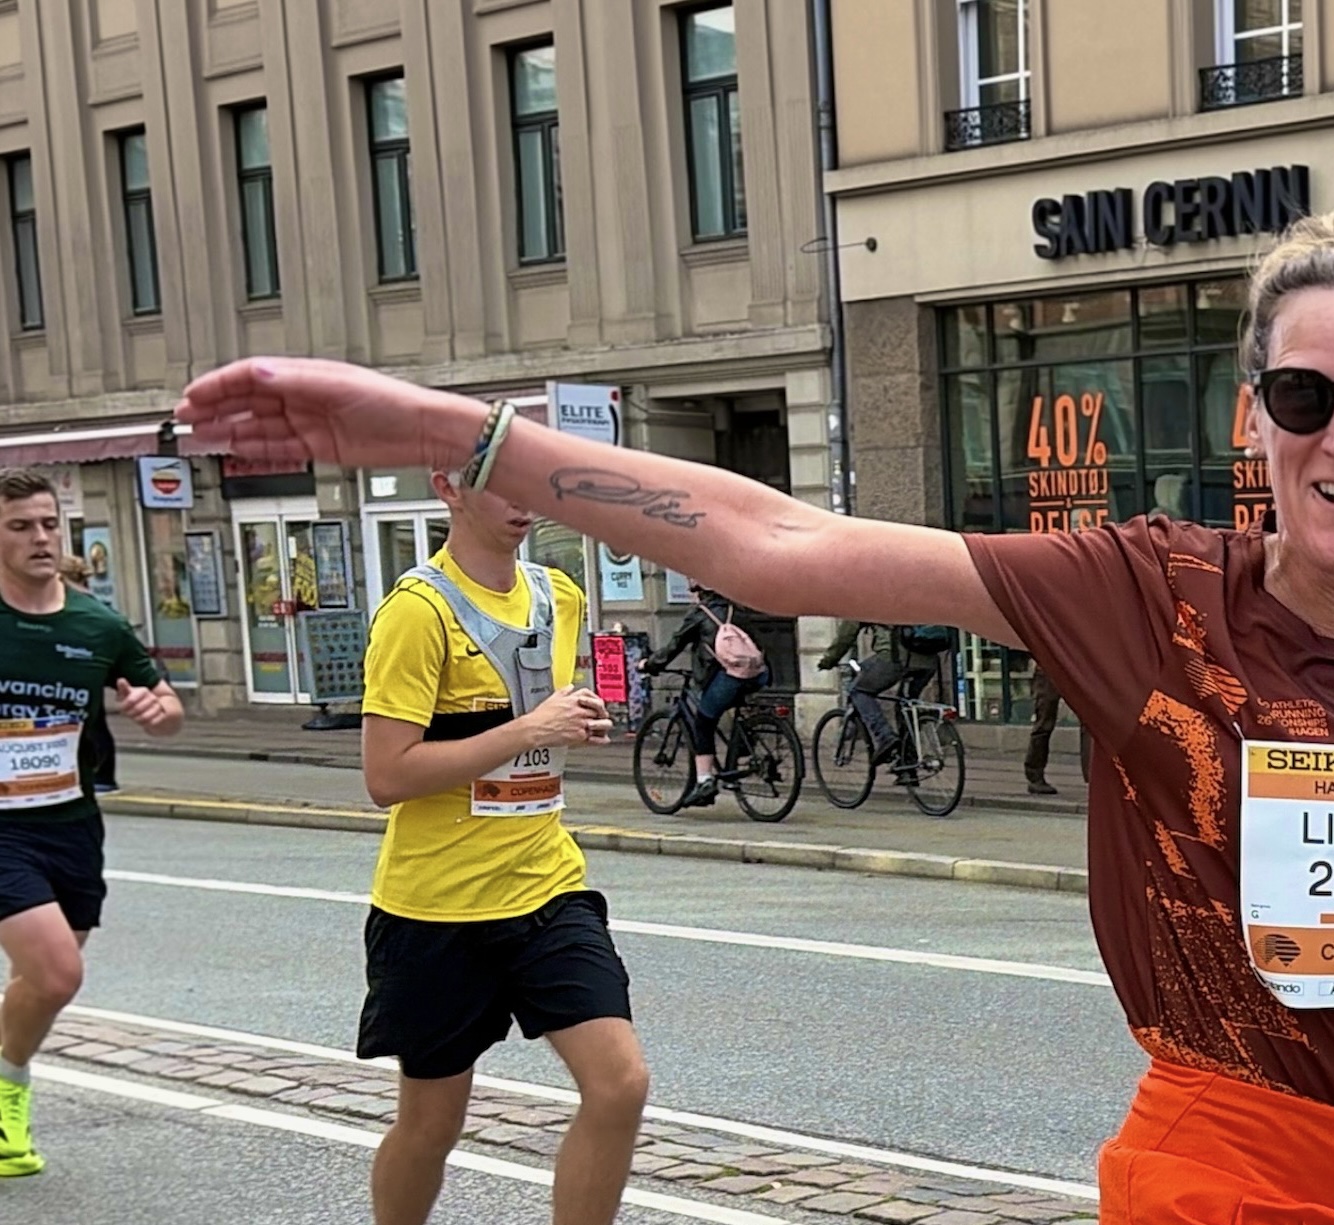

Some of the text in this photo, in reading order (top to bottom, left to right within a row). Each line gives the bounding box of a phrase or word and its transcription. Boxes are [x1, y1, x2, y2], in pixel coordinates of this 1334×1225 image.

[1031, 187, 1134, 260] SAIN
[561, 404, 604, 419] ELITE
[1027, 392, 1108, 468] 40%
[1029, 468, 1108, 497] SKINDTØJ
